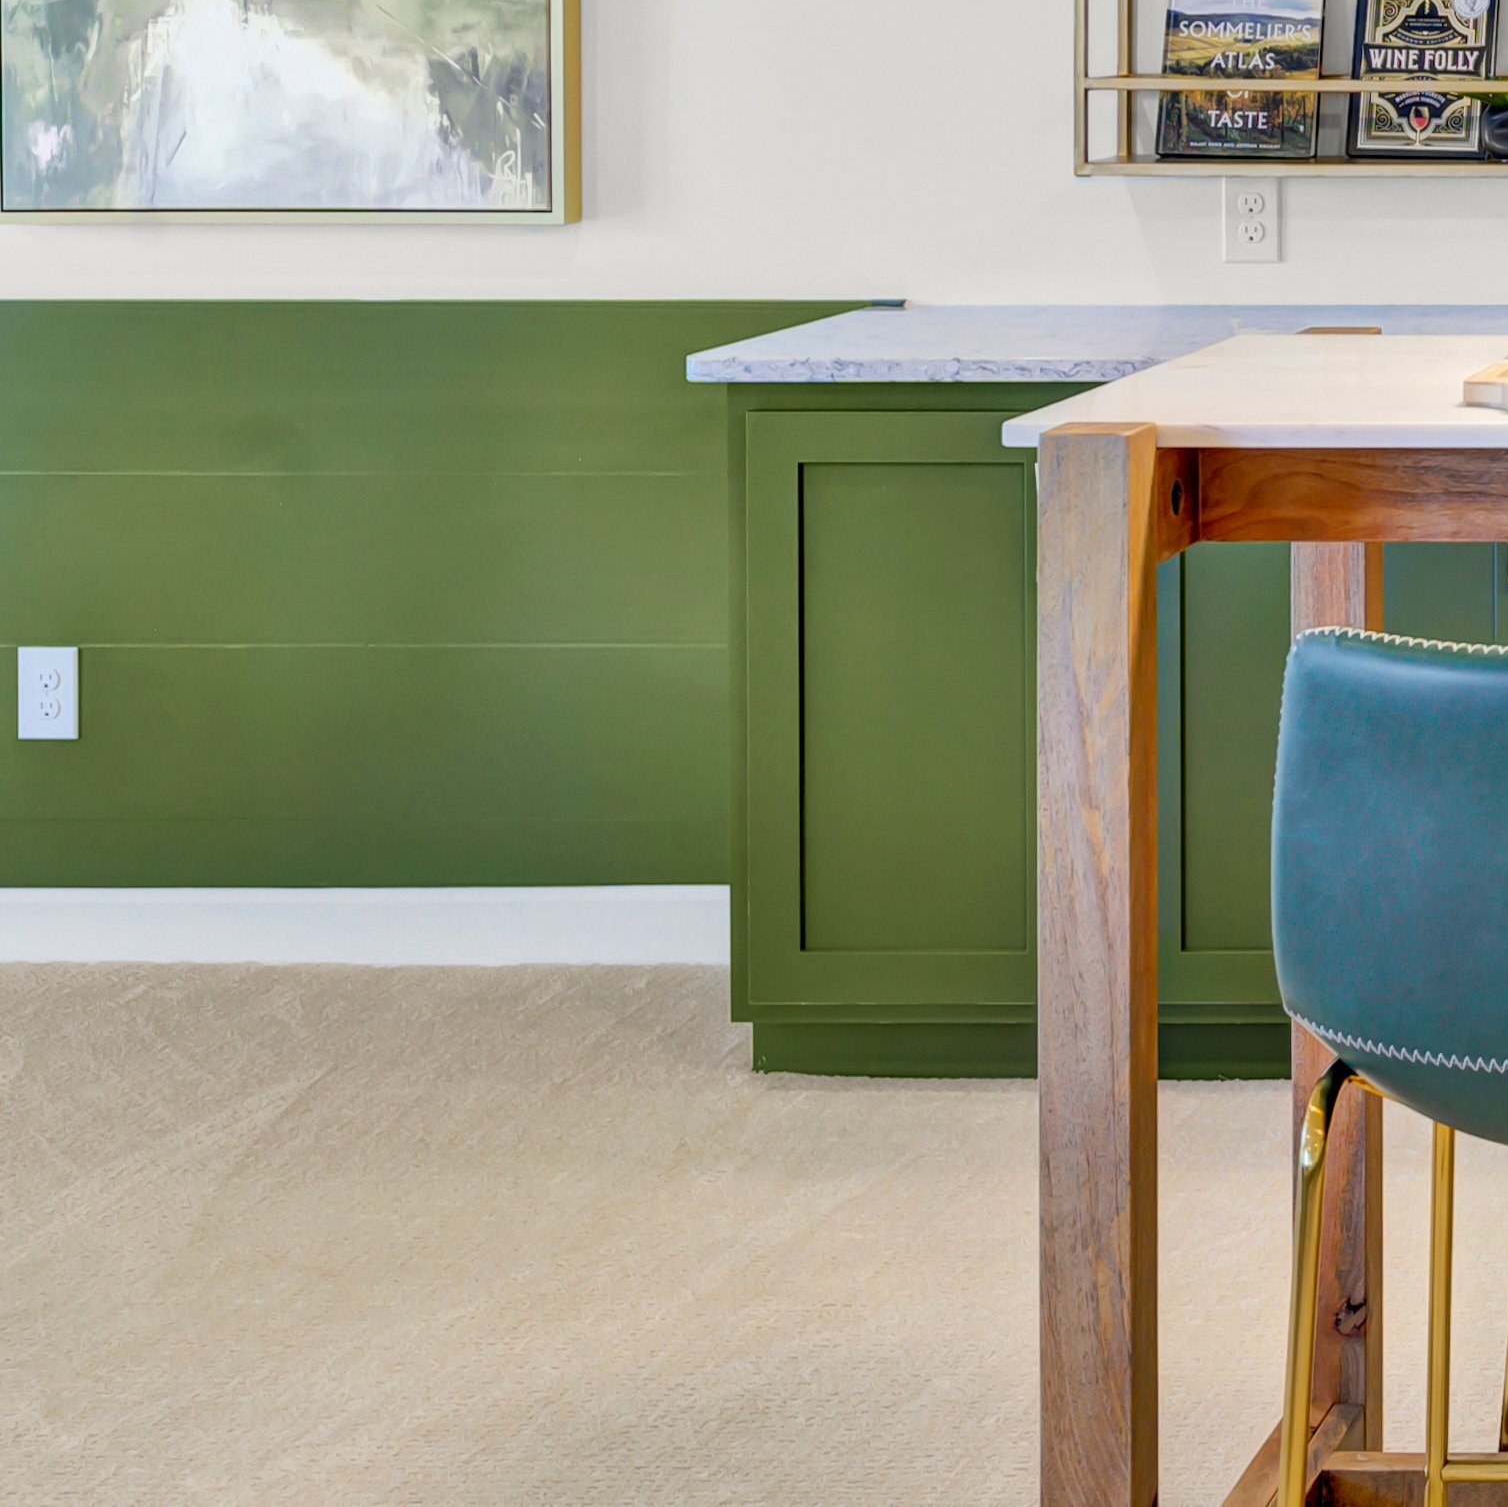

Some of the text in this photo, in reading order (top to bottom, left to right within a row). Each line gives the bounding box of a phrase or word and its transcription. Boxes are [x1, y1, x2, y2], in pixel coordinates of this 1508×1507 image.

[1179, 20, 1312, 41] SOMMELIER'S
[1210, 51, 1275, 70] ATLAS
[1368, 49, 1480, 71] WINE FOLLY
[1207, 109, 1269, 129] TASTE
